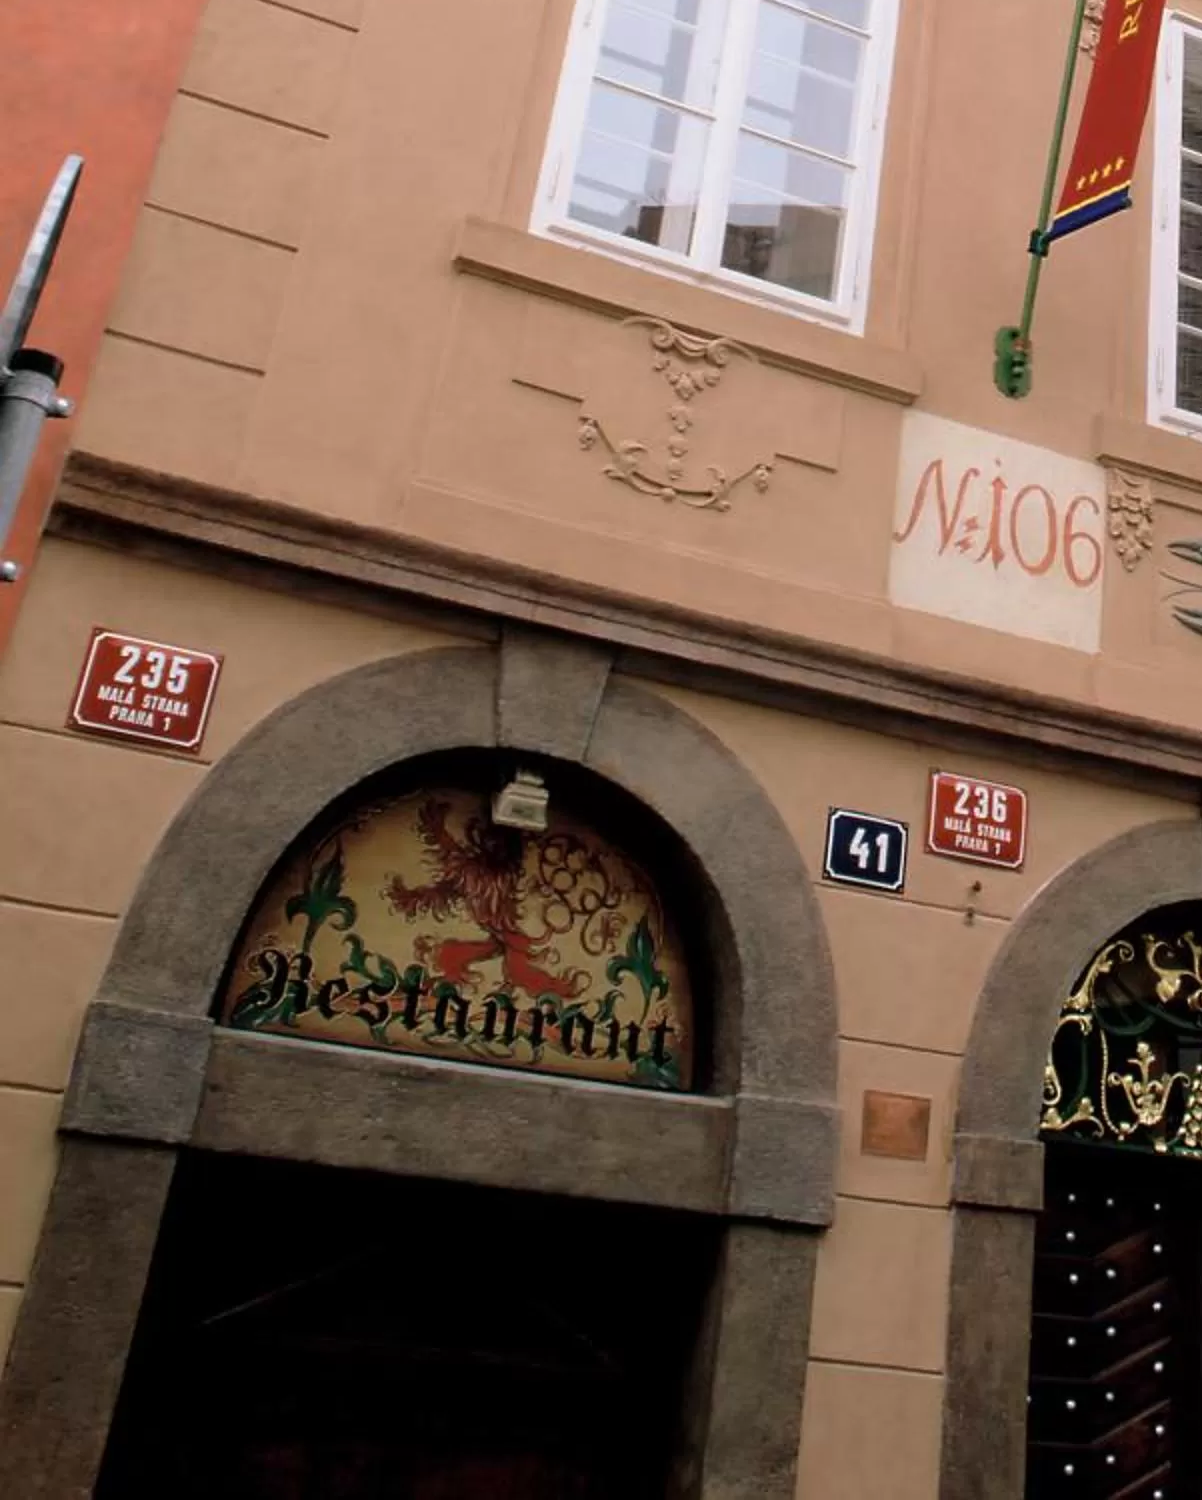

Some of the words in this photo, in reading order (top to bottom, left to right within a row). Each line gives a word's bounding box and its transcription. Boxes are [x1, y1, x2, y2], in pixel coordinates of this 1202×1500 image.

[113, 645, 192, 695] 235
[96, 685, 136, 706] MALÁ
[140, 693, 190, 718] STRANA
[108, 705, 155, 730] PRAHA
[162, 716, 172, 732] 1
[953, 781, 1009, 824] 236
[943, 815, 972, 833] MALÁ
[976, 823, 1013, 844] STRANA
[954, 834, 990, 854] PRAHA
[993, 842, 1002, 857] 1
[849, 827, 891, 874] 41
[238, 948, 674, 1067] Restaurant
